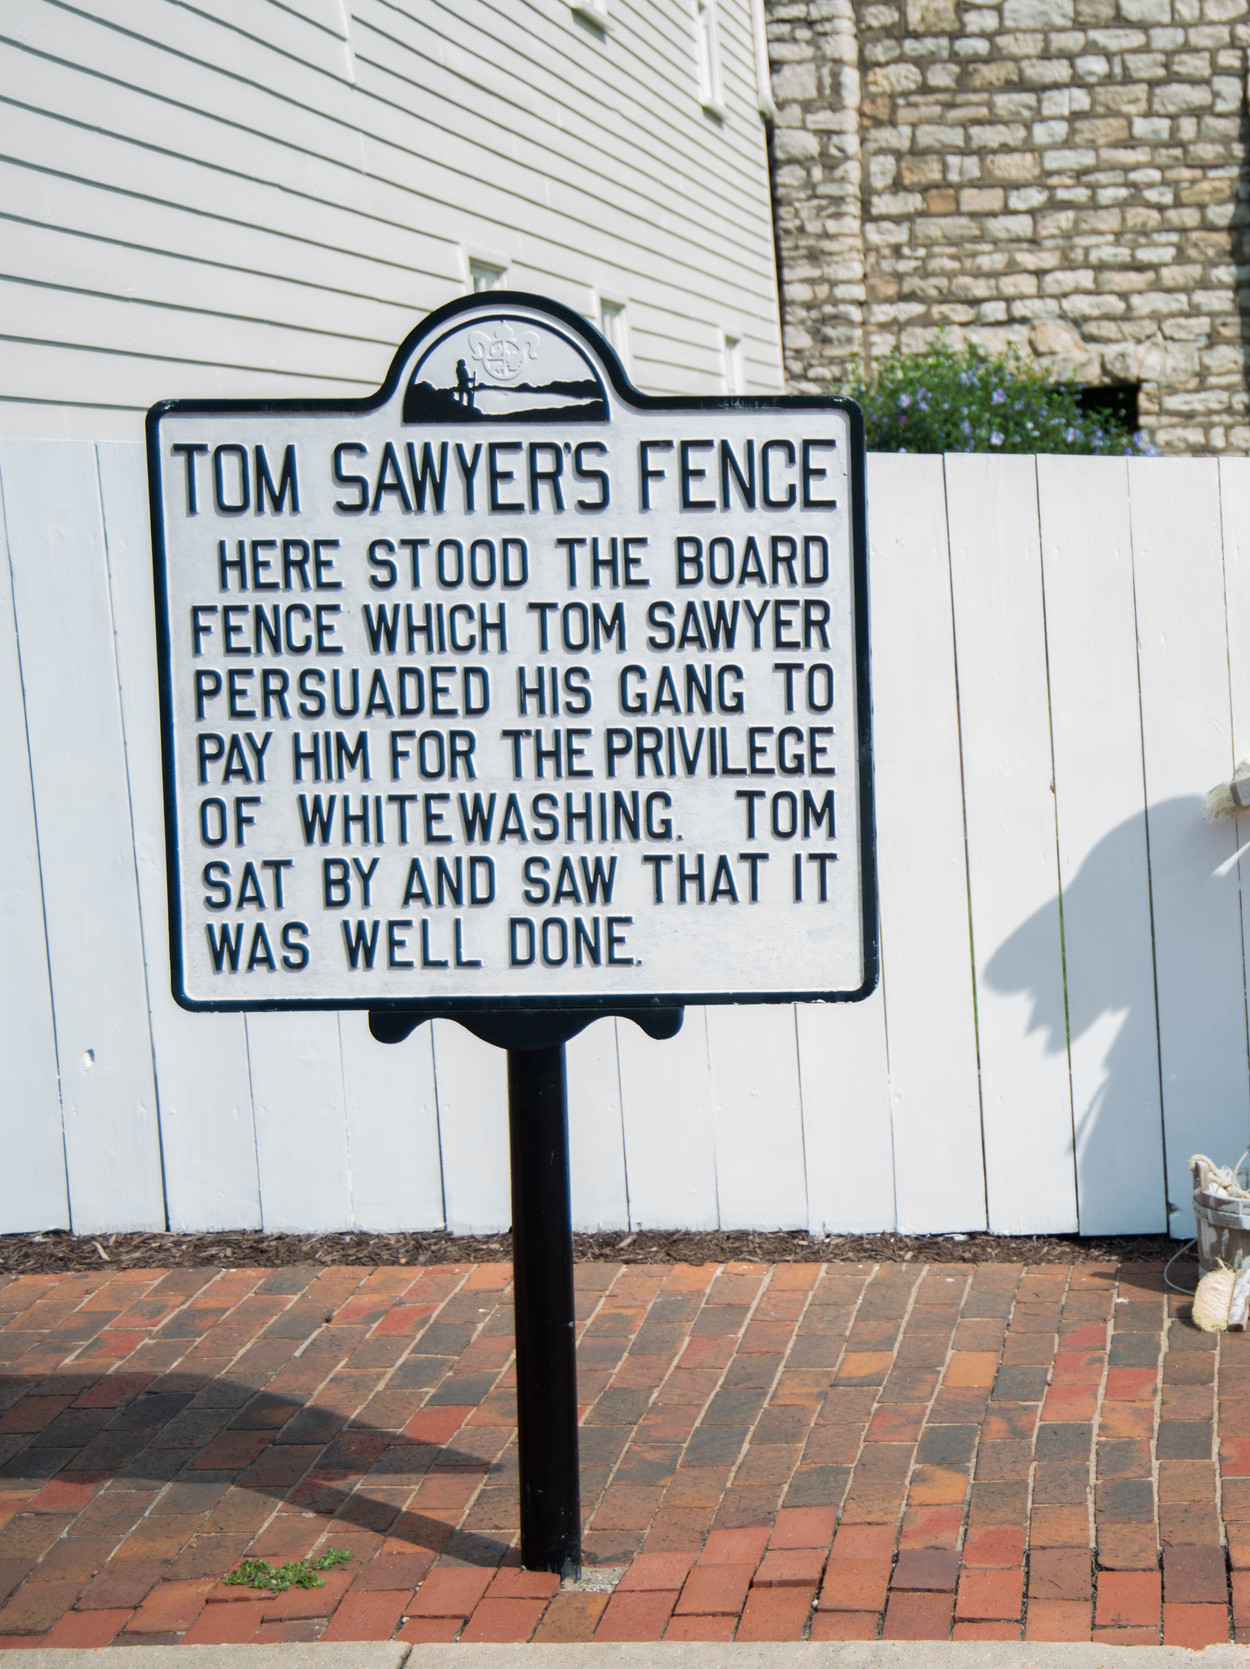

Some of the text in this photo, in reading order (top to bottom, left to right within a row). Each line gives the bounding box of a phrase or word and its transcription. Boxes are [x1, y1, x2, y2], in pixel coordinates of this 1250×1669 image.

[172, 438, 837, 516] TOM SAWYER'S FENCE
[218, 535, 829, 591] HERE STOOD THE BOARD
[190, 599, 831, 656] FENCE WHICH TOM SAWYER
[194, 662, 834, 721] PERSUADED HIS GANG TO
[197, 726, 836, 784] PAY HIM FOR THE PRIVILEGE
[199, 789, 836, 848] OF WHITEWASHING. TOM
[202, 852, 838, 910] SAT BY AND SAW THAT IT
[206, 916, 643, 973] WAS WELL DONE.
